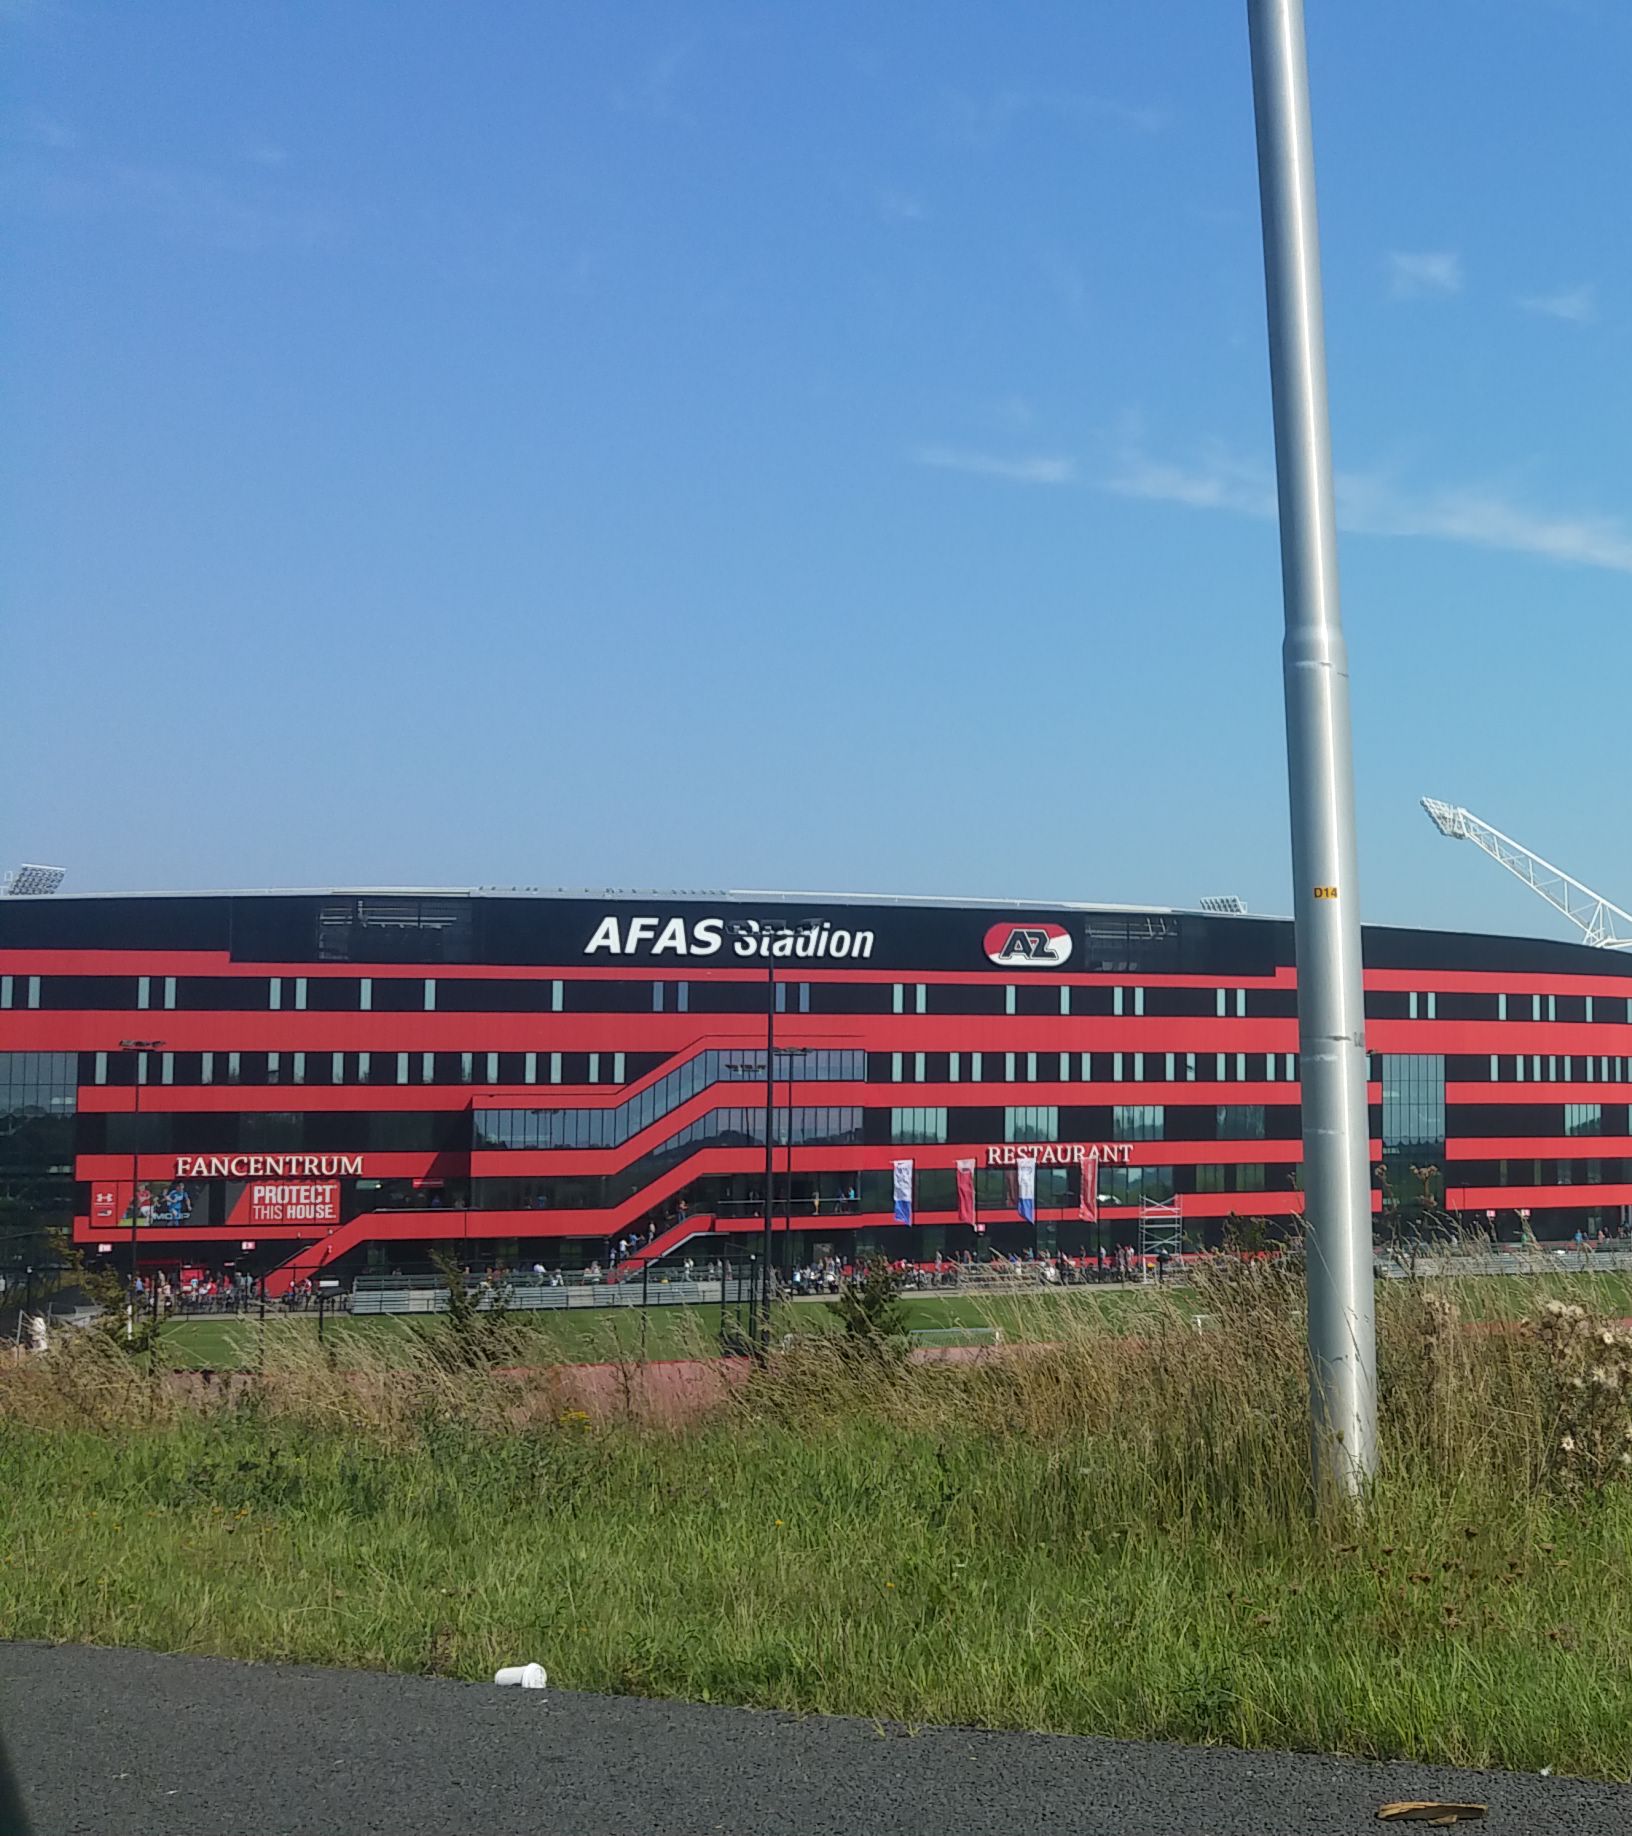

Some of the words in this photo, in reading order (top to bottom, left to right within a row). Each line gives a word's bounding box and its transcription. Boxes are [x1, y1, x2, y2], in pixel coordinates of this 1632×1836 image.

[1314, 887, 1338, 898] D14
[584, 916, 724, 955] AFAS
[999, 928, 1060, 960] AZ
[988, 1144, 1134, 1165] RESTAURANT
[176, 1156, 364, 1177] FANCENTRUM
[253, 1185, 334, 1204] PROTECT
[253, 1204, 283, 1220] THIS
